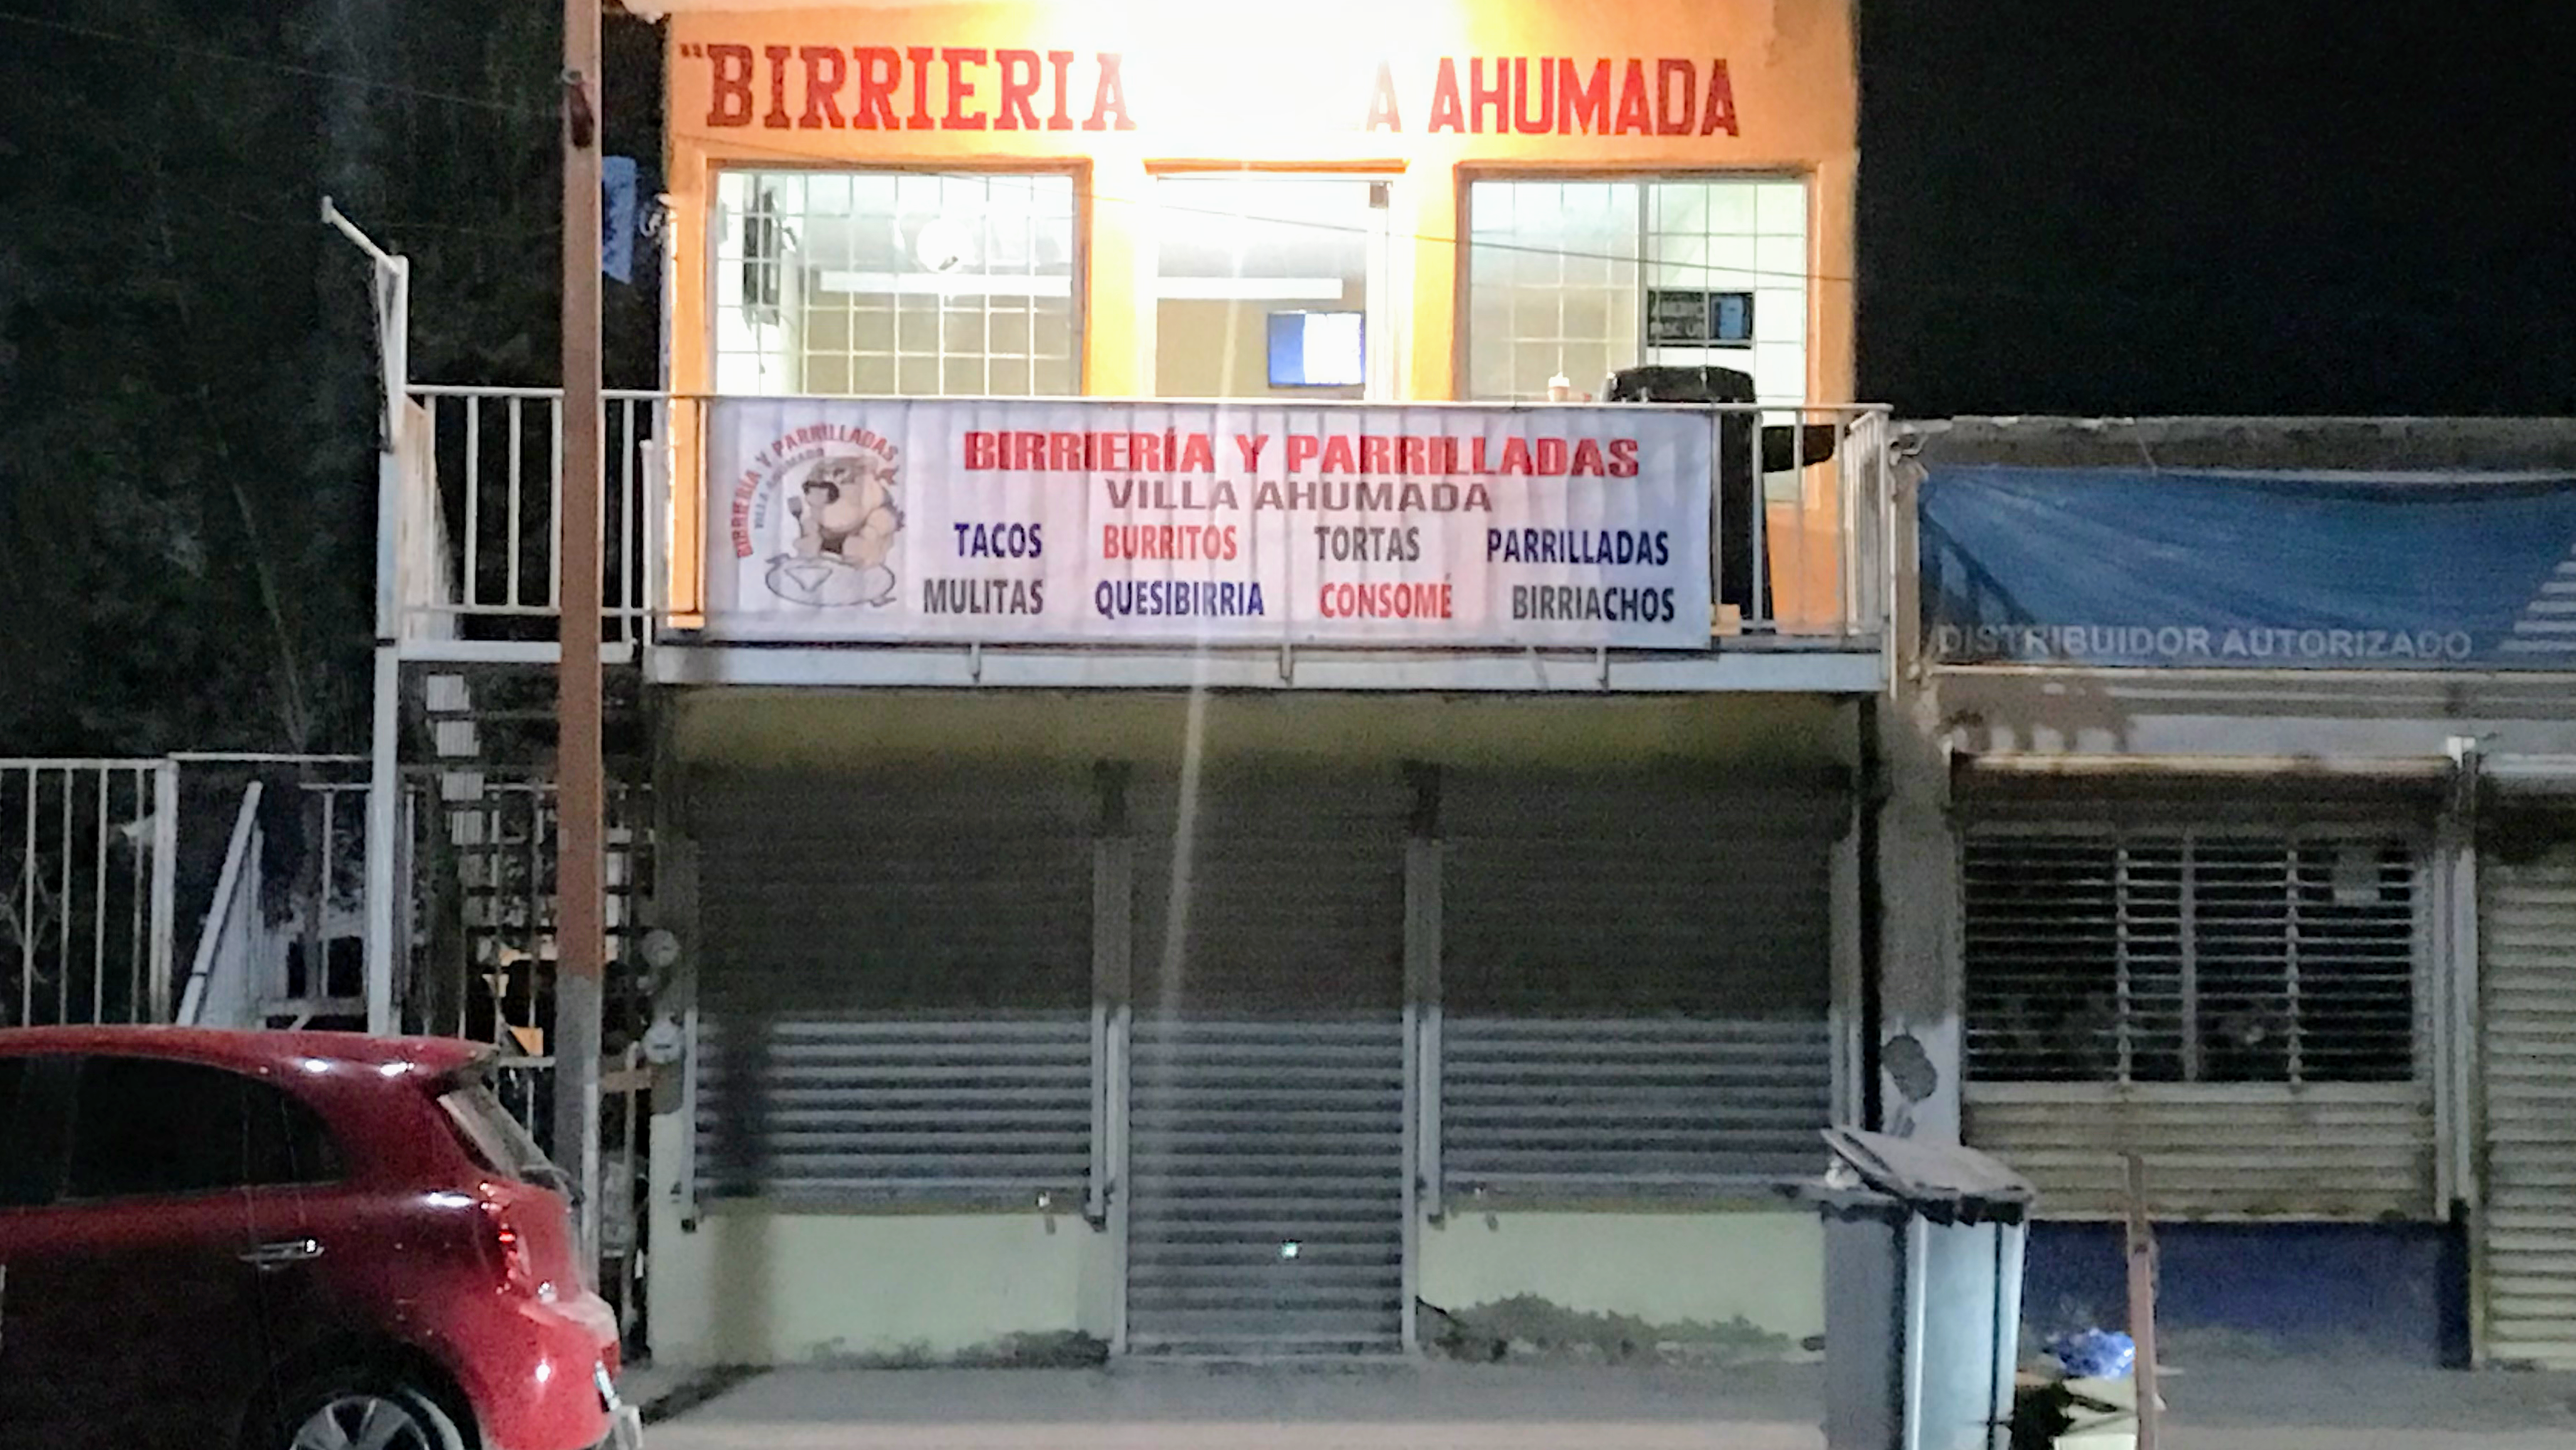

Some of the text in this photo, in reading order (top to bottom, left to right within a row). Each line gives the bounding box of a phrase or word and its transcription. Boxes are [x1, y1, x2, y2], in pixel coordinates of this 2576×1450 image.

[1427, 57, 1740, 137] AHUMADA
[964, 427, 1639, 478] BIRRIERÍA Y PARRILLADAS
[1106, 478, 1493, 513] VILLA AHUMADA
[954, 523, 1042, 559] TACOS
[1103, 525, 1237, 560] BURRITOS
[1314, 526, 1420, 562] TORTAS
[1487, 528, 1669, 566] PARRILLADAS
[924, 579, 1044, 614] MULITAS
[1094, 580, 1265, 621] QUESIBIRRIA
[1320, 573, 1452, 619] CONSOMÉ
[1512, 584, 1675, 624] BIRRIACHOS
[1936, 624, 2473, 661] DISTRIBUIDOR AUTORIZADO
